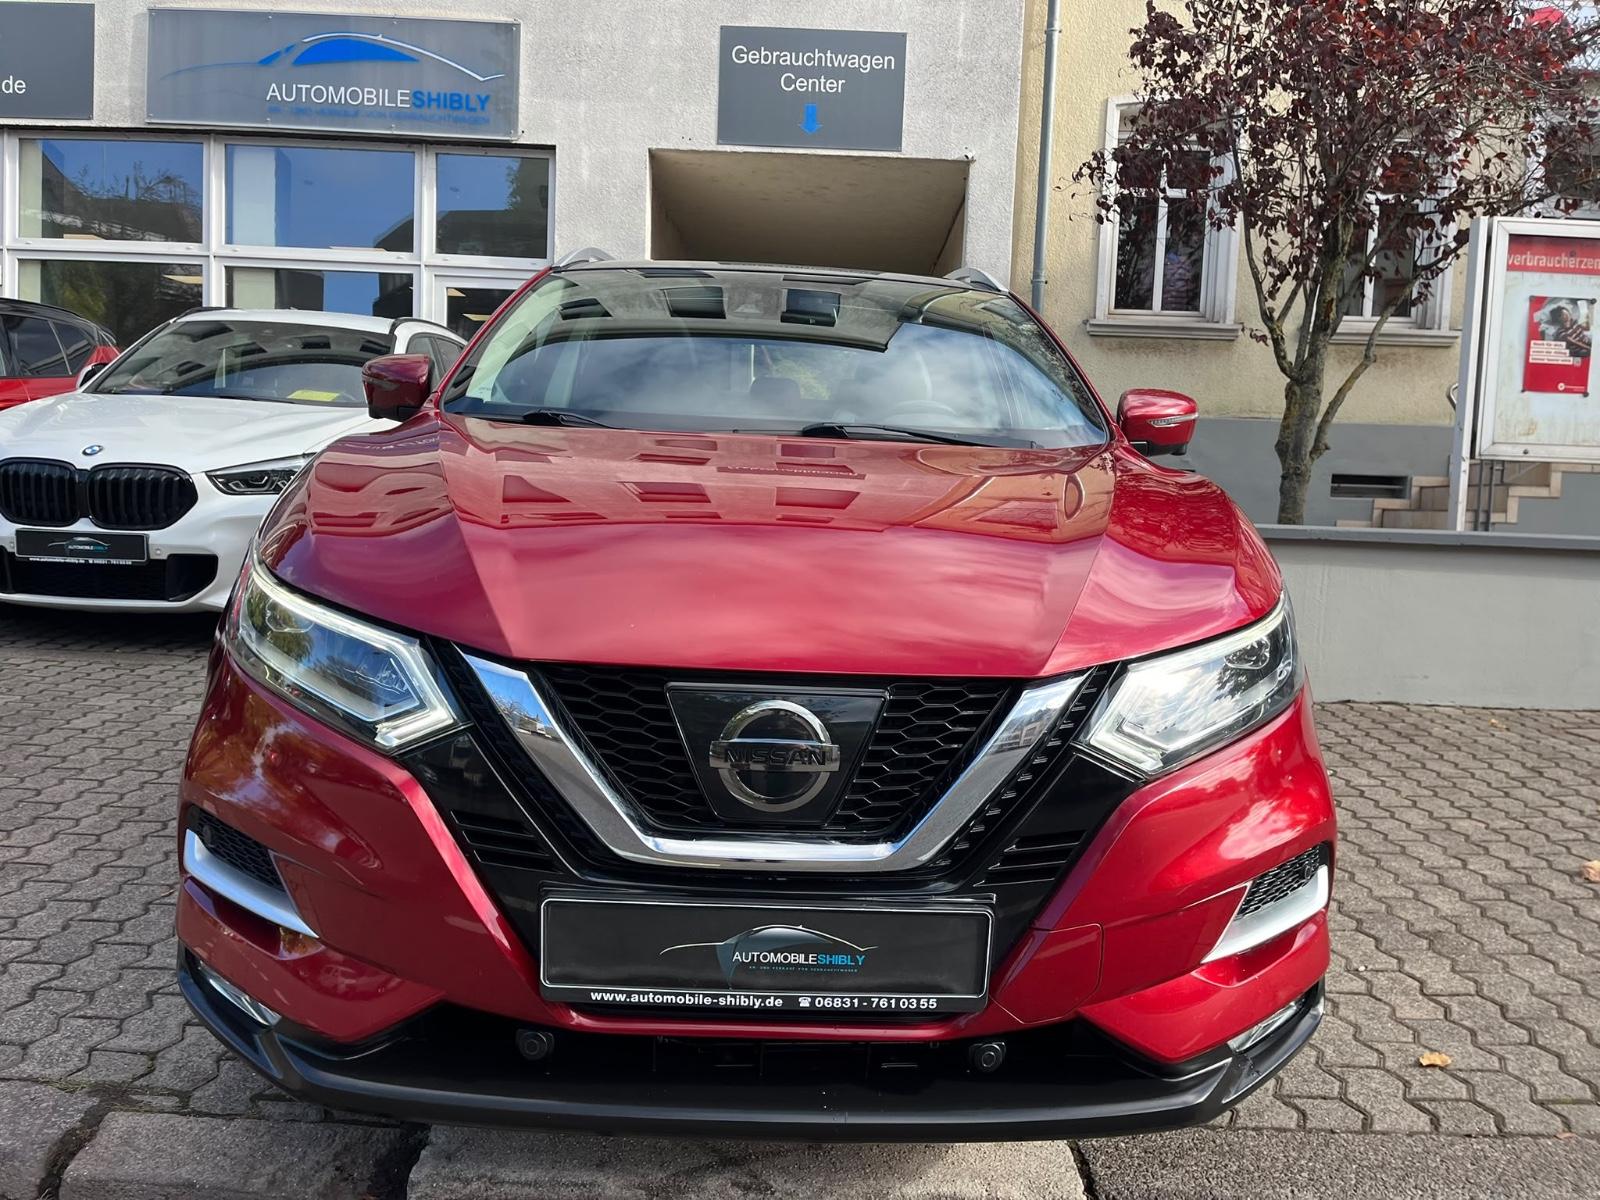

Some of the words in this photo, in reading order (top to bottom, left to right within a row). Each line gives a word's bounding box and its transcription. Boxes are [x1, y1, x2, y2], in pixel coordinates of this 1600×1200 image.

[731, 45, 895, 73] Gebrauchtwagen
[780, 73, 846, 93] Center
[724, 747, 826, 766] NISSAN
[590, 991, 783, 1009] www.automobile-shibly.de
[815, 997, 859, 1008] 06831
